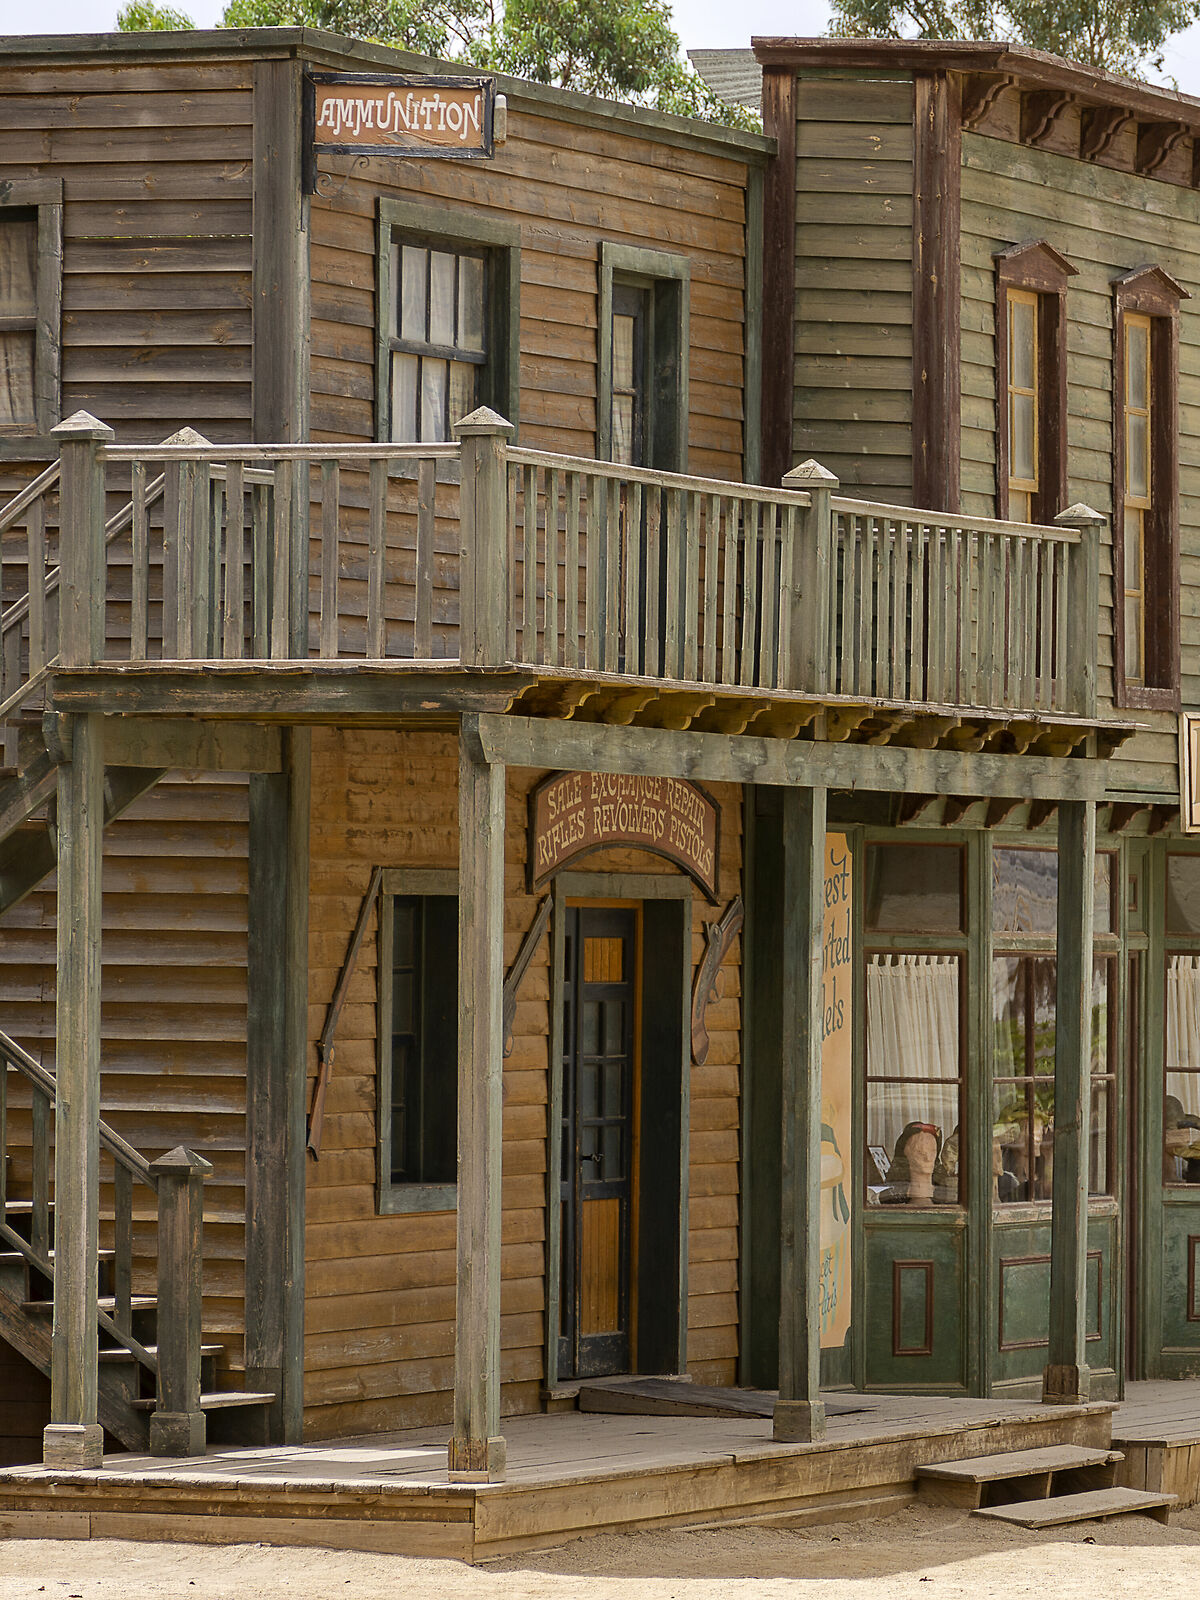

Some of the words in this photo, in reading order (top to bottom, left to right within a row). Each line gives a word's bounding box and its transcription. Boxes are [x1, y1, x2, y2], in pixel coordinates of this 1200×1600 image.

[317, 91, 481, 140] AMMUNITION
[547, 774, 582, 820] SALE
[591, 772, 662, 804] EXCHANGE
[665, 777, 706, 837] REPAIR
[537, 807, 586, 866] RIFLES
[593, 797, 666, 842] REVOLVERS
[669, 815, 714, 876] PISTOLS
[824, 848, 850, 908] est
